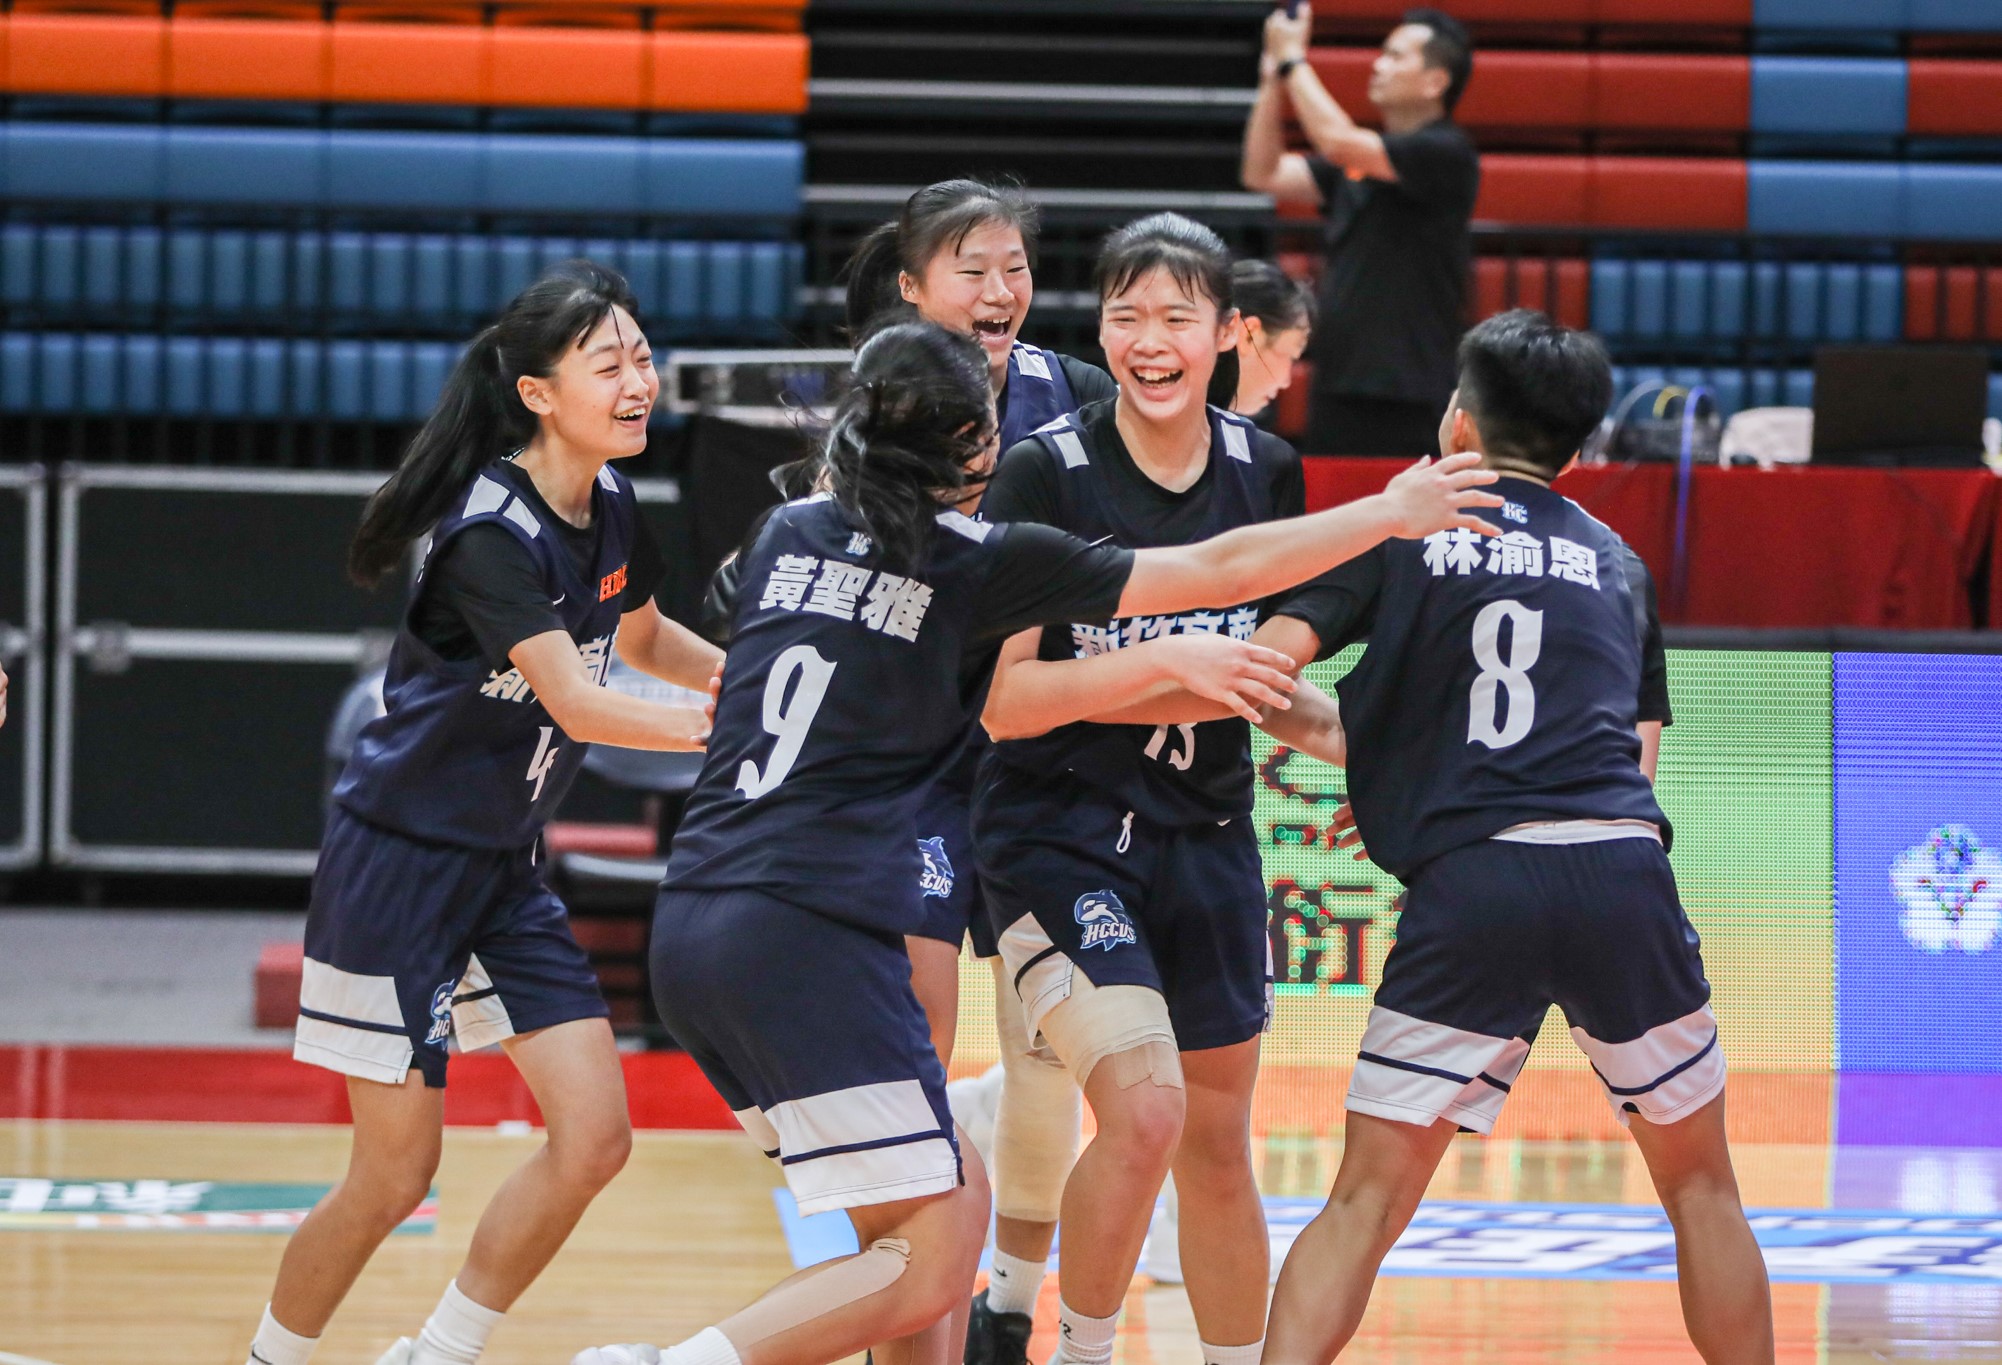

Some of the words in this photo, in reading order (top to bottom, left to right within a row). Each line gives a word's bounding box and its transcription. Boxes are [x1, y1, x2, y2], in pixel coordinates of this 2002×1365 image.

[1423, 527, 1601, 591] 林渝恩
[734, 644, 838, 799] 9
[1466, 599, 1544, 750] 8
